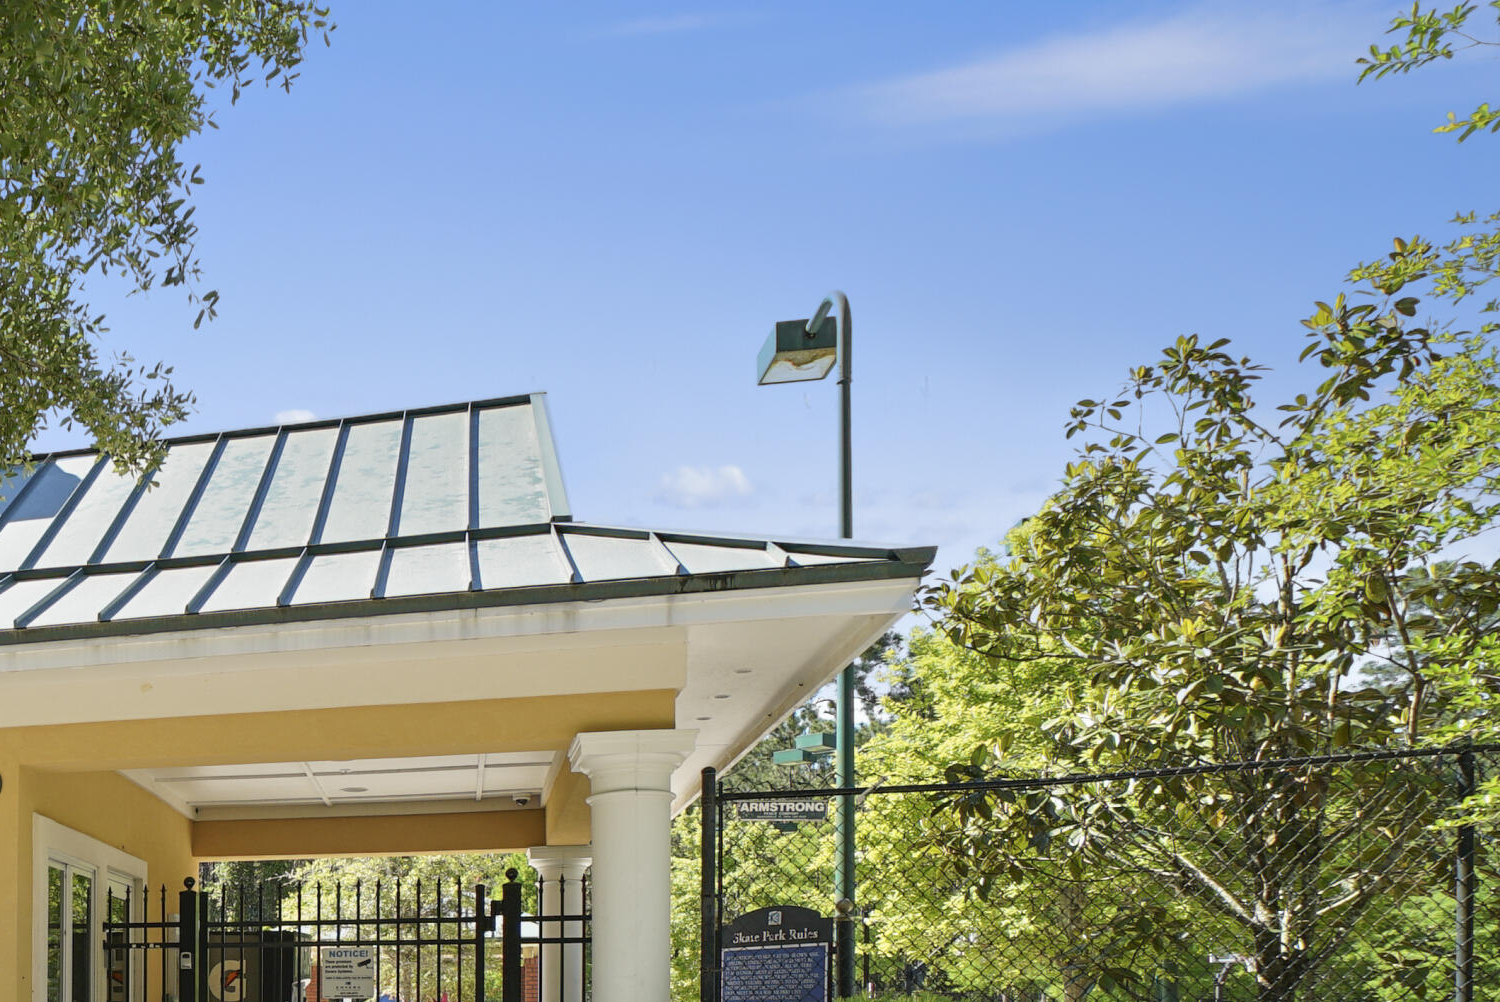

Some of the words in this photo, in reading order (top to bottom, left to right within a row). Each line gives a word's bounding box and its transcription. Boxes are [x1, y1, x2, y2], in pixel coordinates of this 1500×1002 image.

[739, 802, 825, 812] ARMSTRONG
[732, 931, 760, 944] Skate
[762, 929, 786, 942] Park
[789, 928, 819, 941] Rules
[329, 950, 369, 958] NOTICE!
[208, 959, 247, 1002] G
